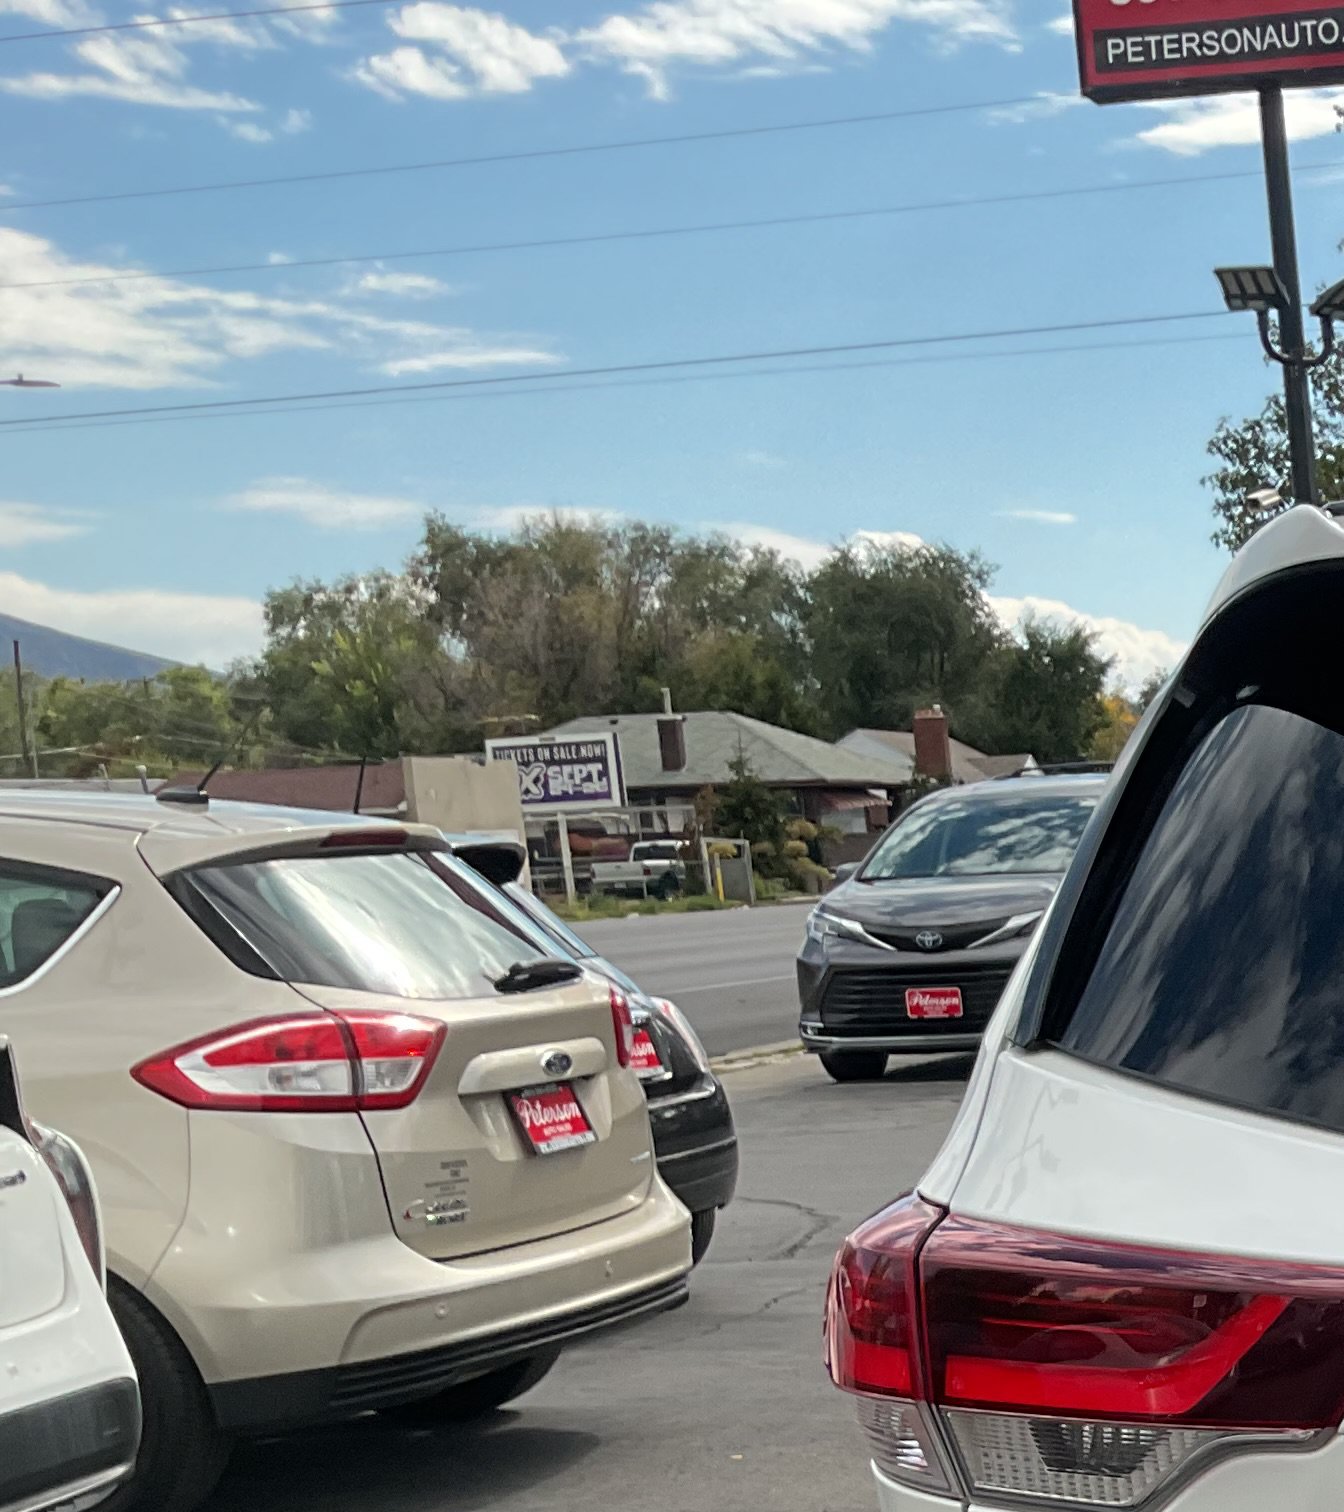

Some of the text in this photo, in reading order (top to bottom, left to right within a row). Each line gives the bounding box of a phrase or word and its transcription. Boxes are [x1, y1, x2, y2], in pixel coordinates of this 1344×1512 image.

[537, 747, 550, 761] ON
[553, 744, 577, 760] SALE
[580, 743, 605, 759] NOW!
[516, 1099, 582, 1128] Peterson
